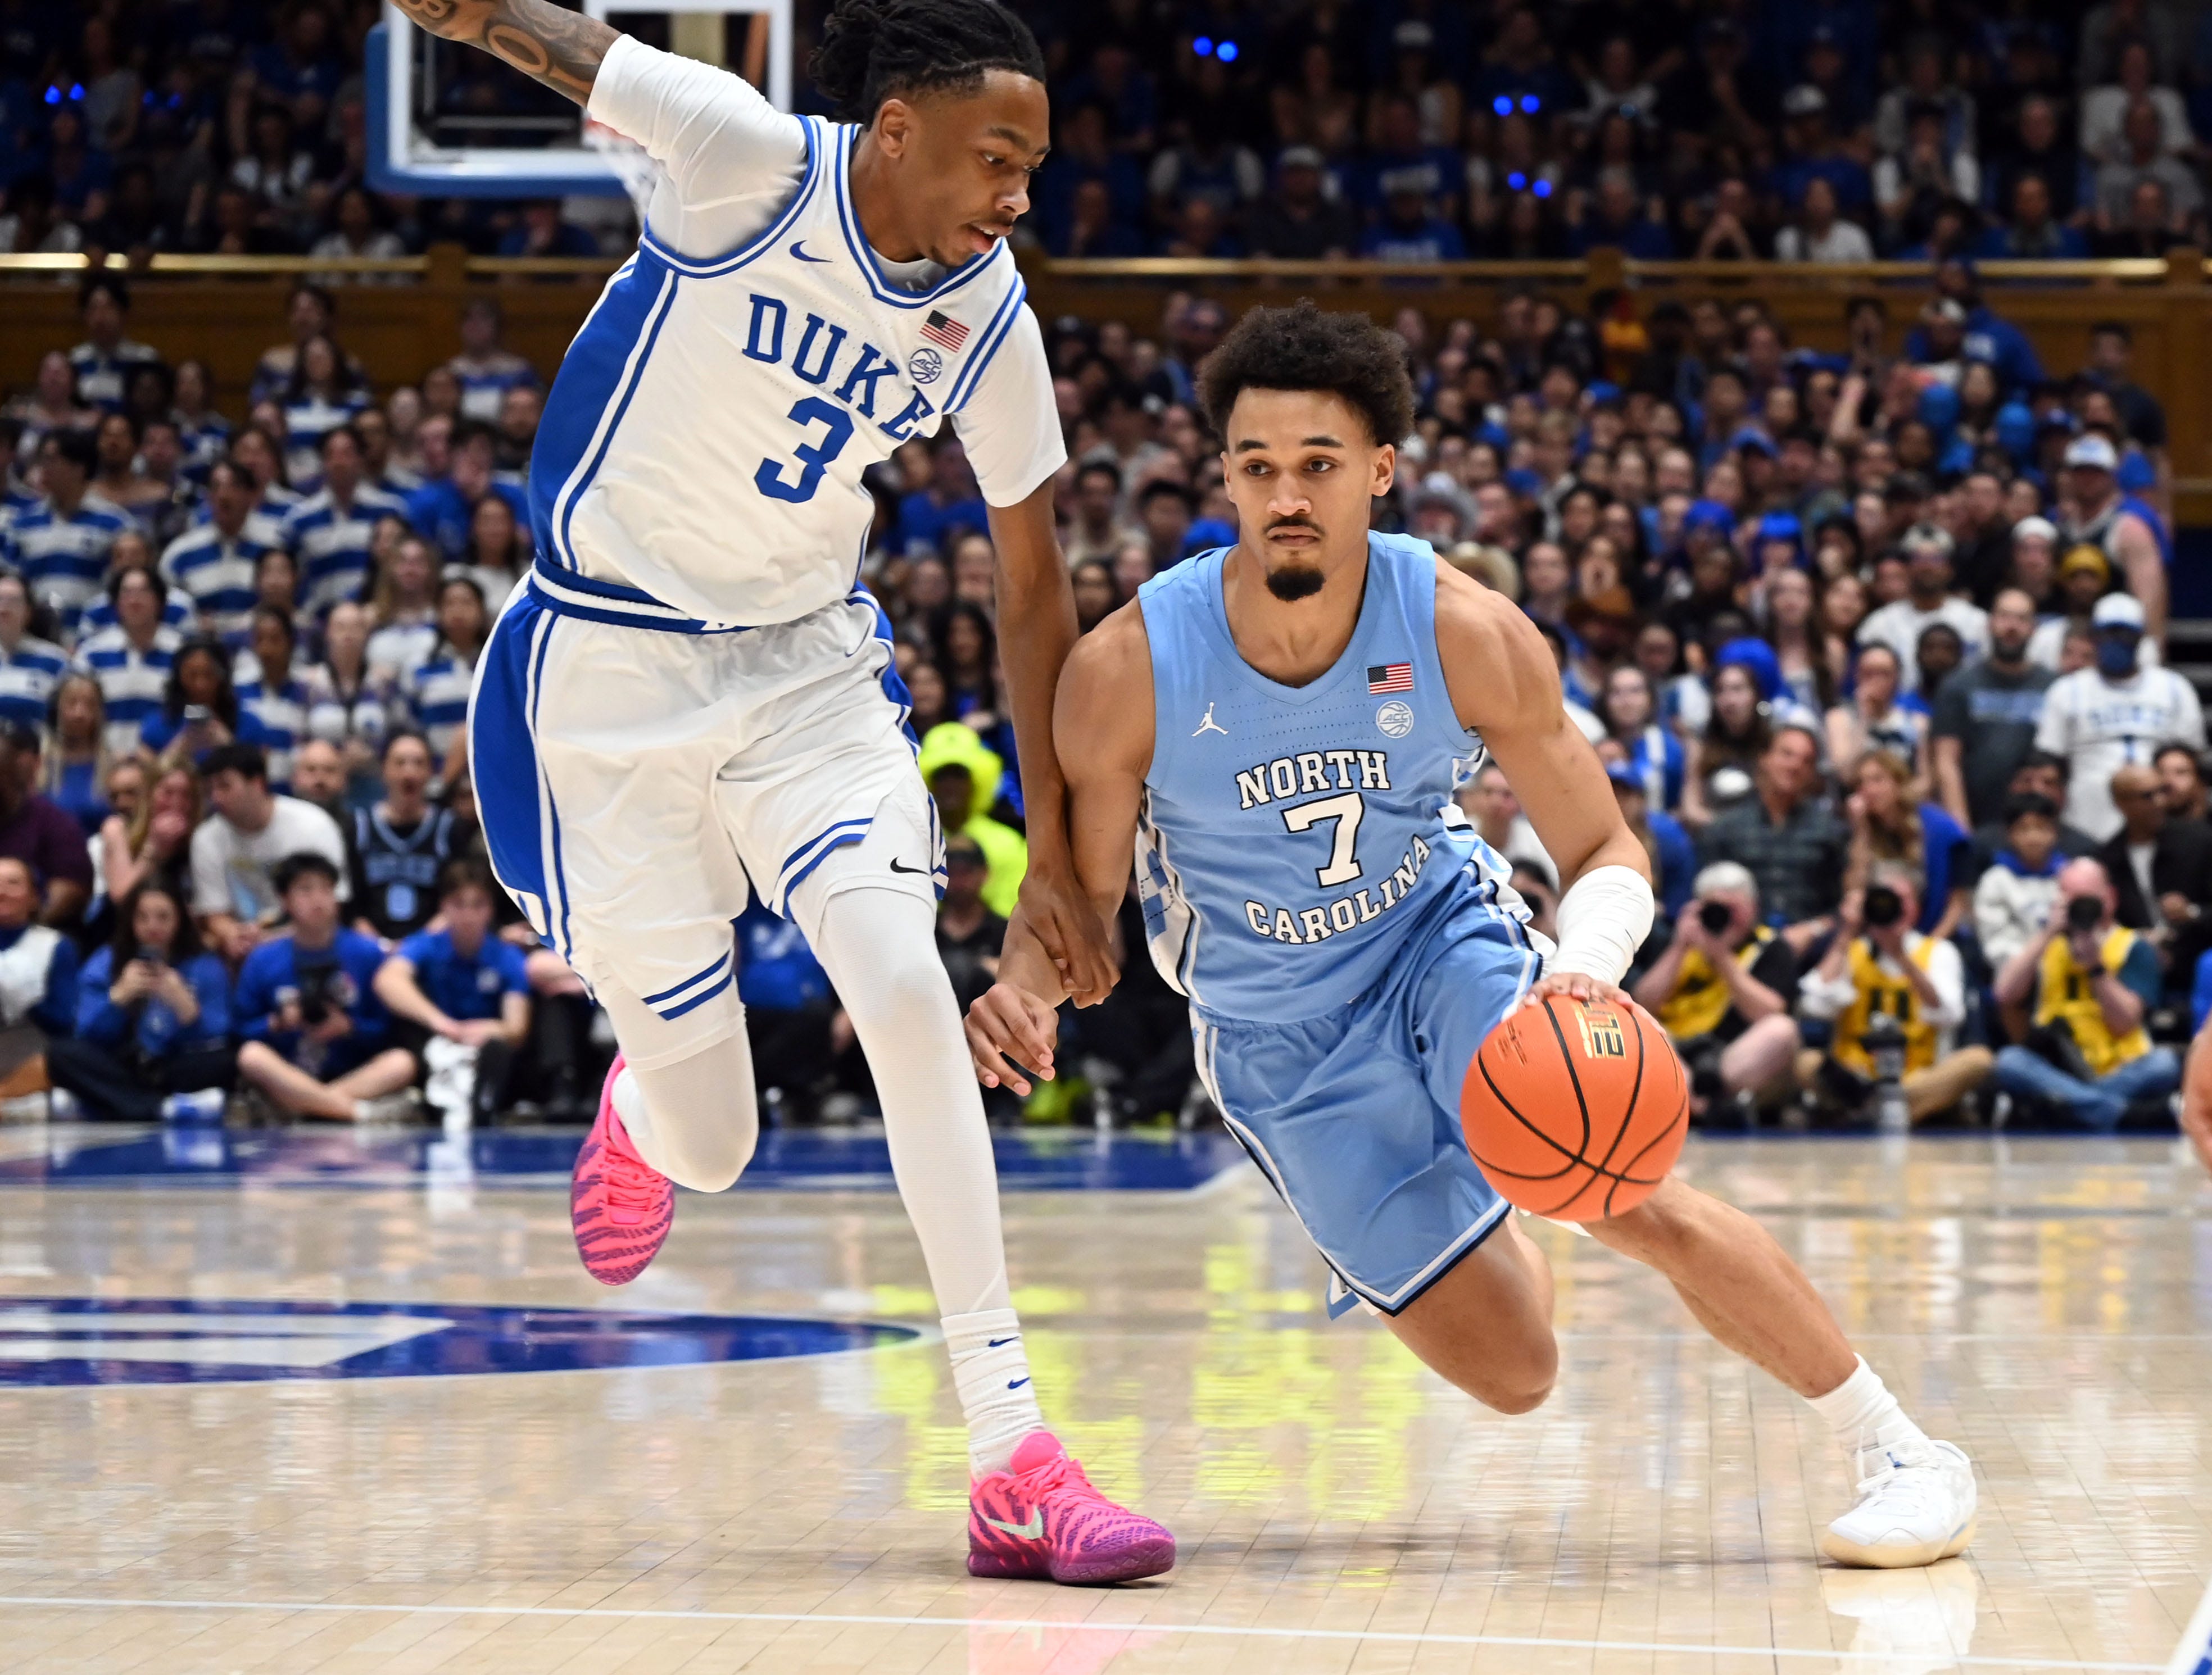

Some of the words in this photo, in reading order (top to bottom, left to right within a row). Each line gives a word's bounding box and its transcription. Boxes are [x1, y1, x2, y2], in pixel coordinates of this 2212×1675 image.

[742, 293, 935, 441] DUKE
[754, 396, 855, 503] 3
[1235, 750, 1391, 810] NORTH
[1244, 834, 1431, 945] CAROLINA
[1280, 792, 1365, 888] 7
